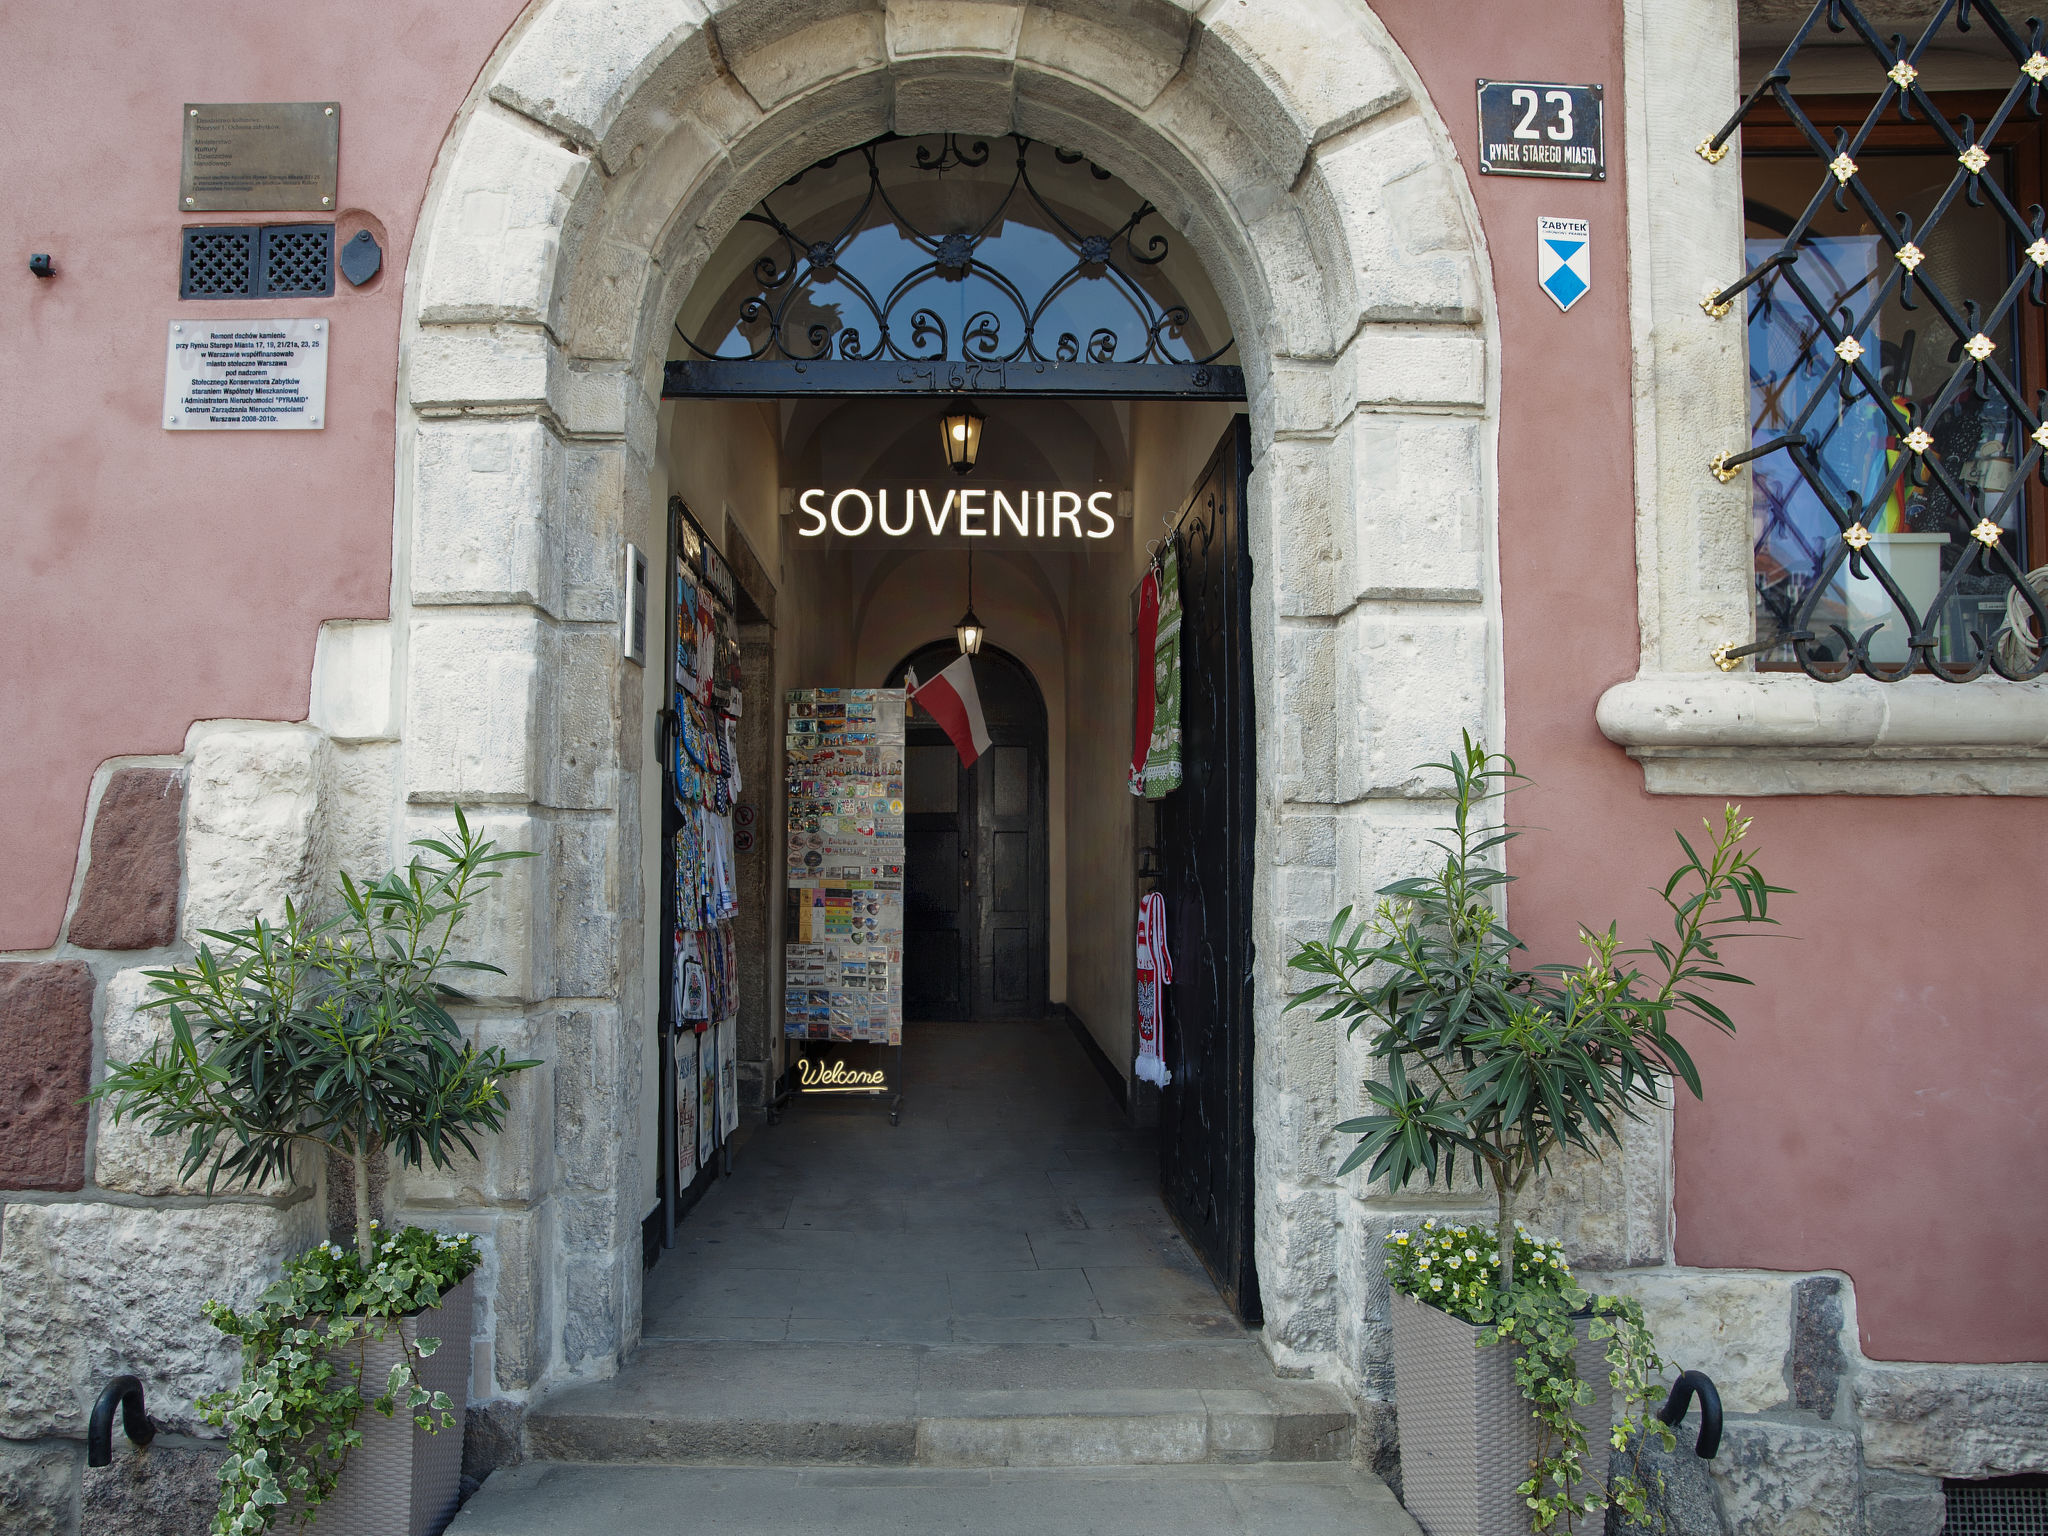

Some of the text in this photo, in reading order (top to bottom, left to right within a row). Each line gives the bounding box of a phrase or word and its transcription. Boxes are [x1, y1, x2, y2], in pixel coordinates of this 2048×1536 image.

[1511, 88, 1574, 141] 23
[1489, 143, 1597, 166] RYNEK STAREGO MIASTA
[1542, 220, 1587, 232] ZABYTEK
[259, 331, 286, 339] kamienic
[190, 342, 209, 350] Rynku
[209, 341, 233, 350] Starego
[256, 341, 265, 349] 17,
[267, 341, 276, 349] 19,
[277, 341, 299, 349] 21/21a,
[300, 340, 310, 348] 23,
[311, 340, 320, 348] 25
[241, 350, 295, 359] współfinansowało
[225, 369, 237, 377] pod
[191, 378, 228, 386] Stołecznego
[271, 378, 300, 386] Zabytków
[223, 387, 254, 396] Wspólnoty
[255, 387, 300, 396] Mieszkaniowej
[230, 396, 274, 404] Nieruchomości
[211, 406, 248, 414] Zarządzania
[798, 488, 1115, 538] SOUVENIRS
[798, 1059, 884, 1085] Welcome
